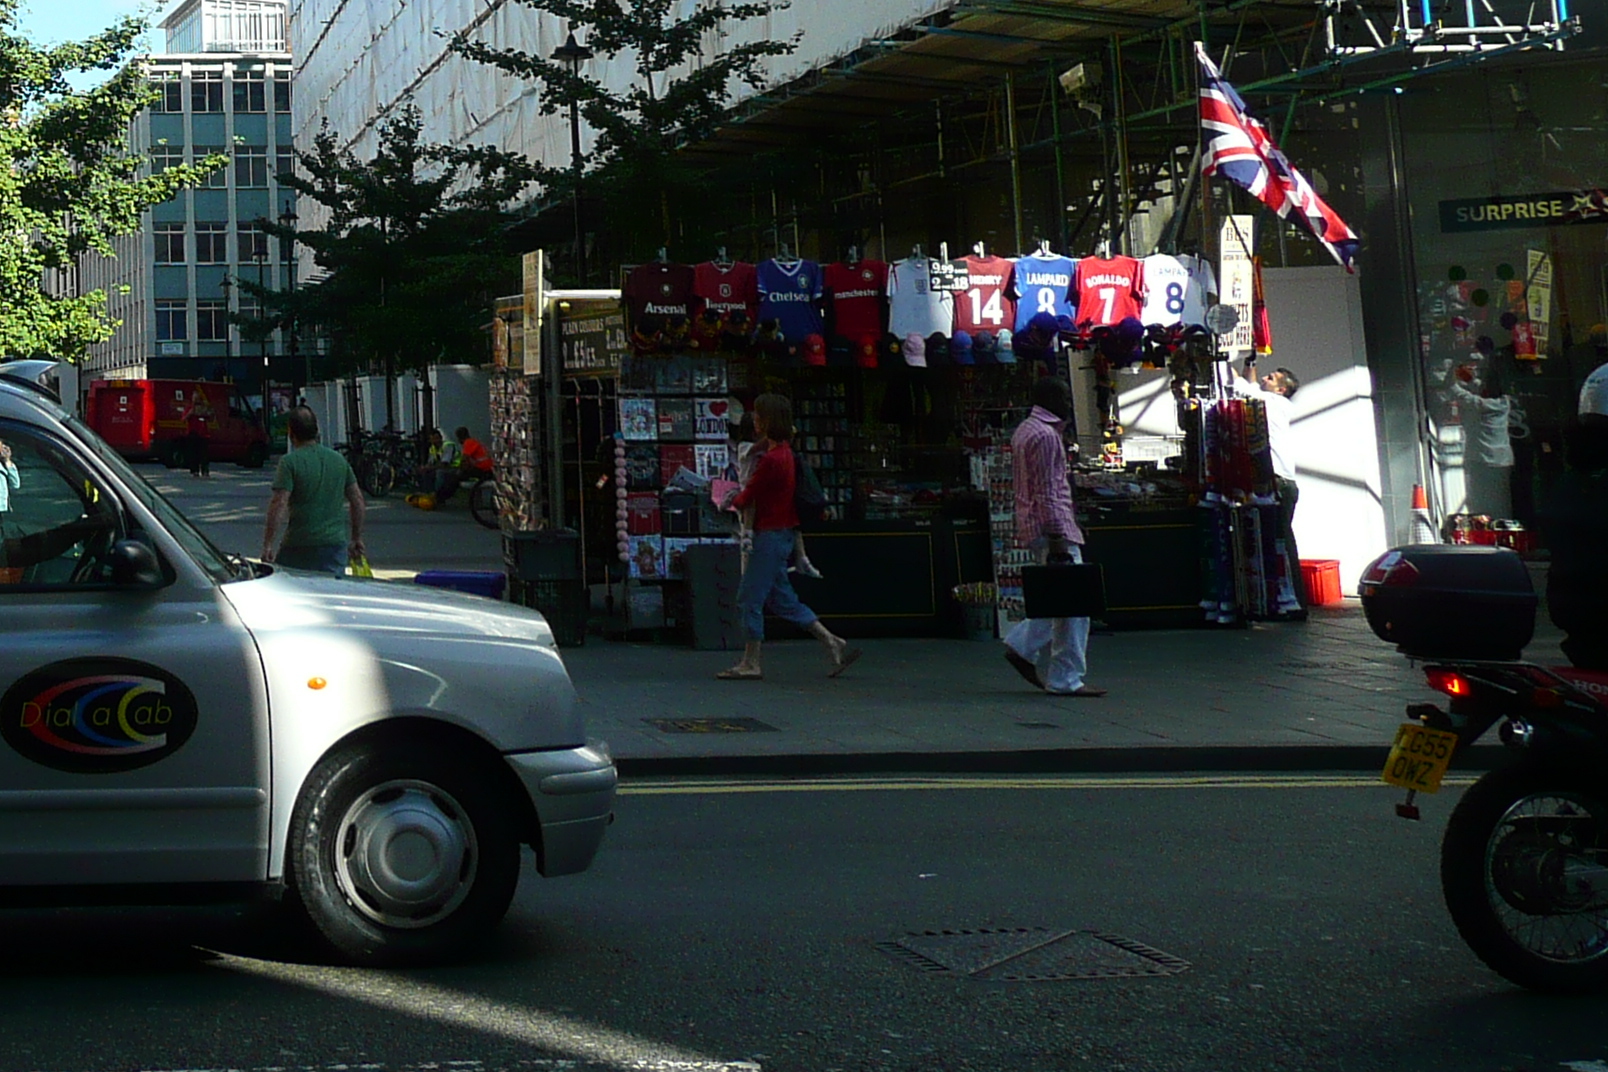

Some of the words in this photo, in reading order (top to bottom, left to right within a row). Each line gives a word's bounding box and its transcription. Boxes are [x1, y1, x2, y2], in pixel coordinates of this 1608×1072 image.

[1456, 200, 1563, 222] SURPRISE
[969, 274, 1002, 286] HENRY
[1026, 273, 1069, 286] LAMPARD
[1086, 276, 1130, 288] RONALDO
[769, 291, 810, 304] Chelsea
[1037, 288, 1056, 315] 8
[1166, 282, 1185, 314] 8
[645, 301, 687, 316] Arsenal
[968, 289, 1004, 325] 14
[1099, 288, 1117, 324] 7
[697, 401, 707, 417] I
